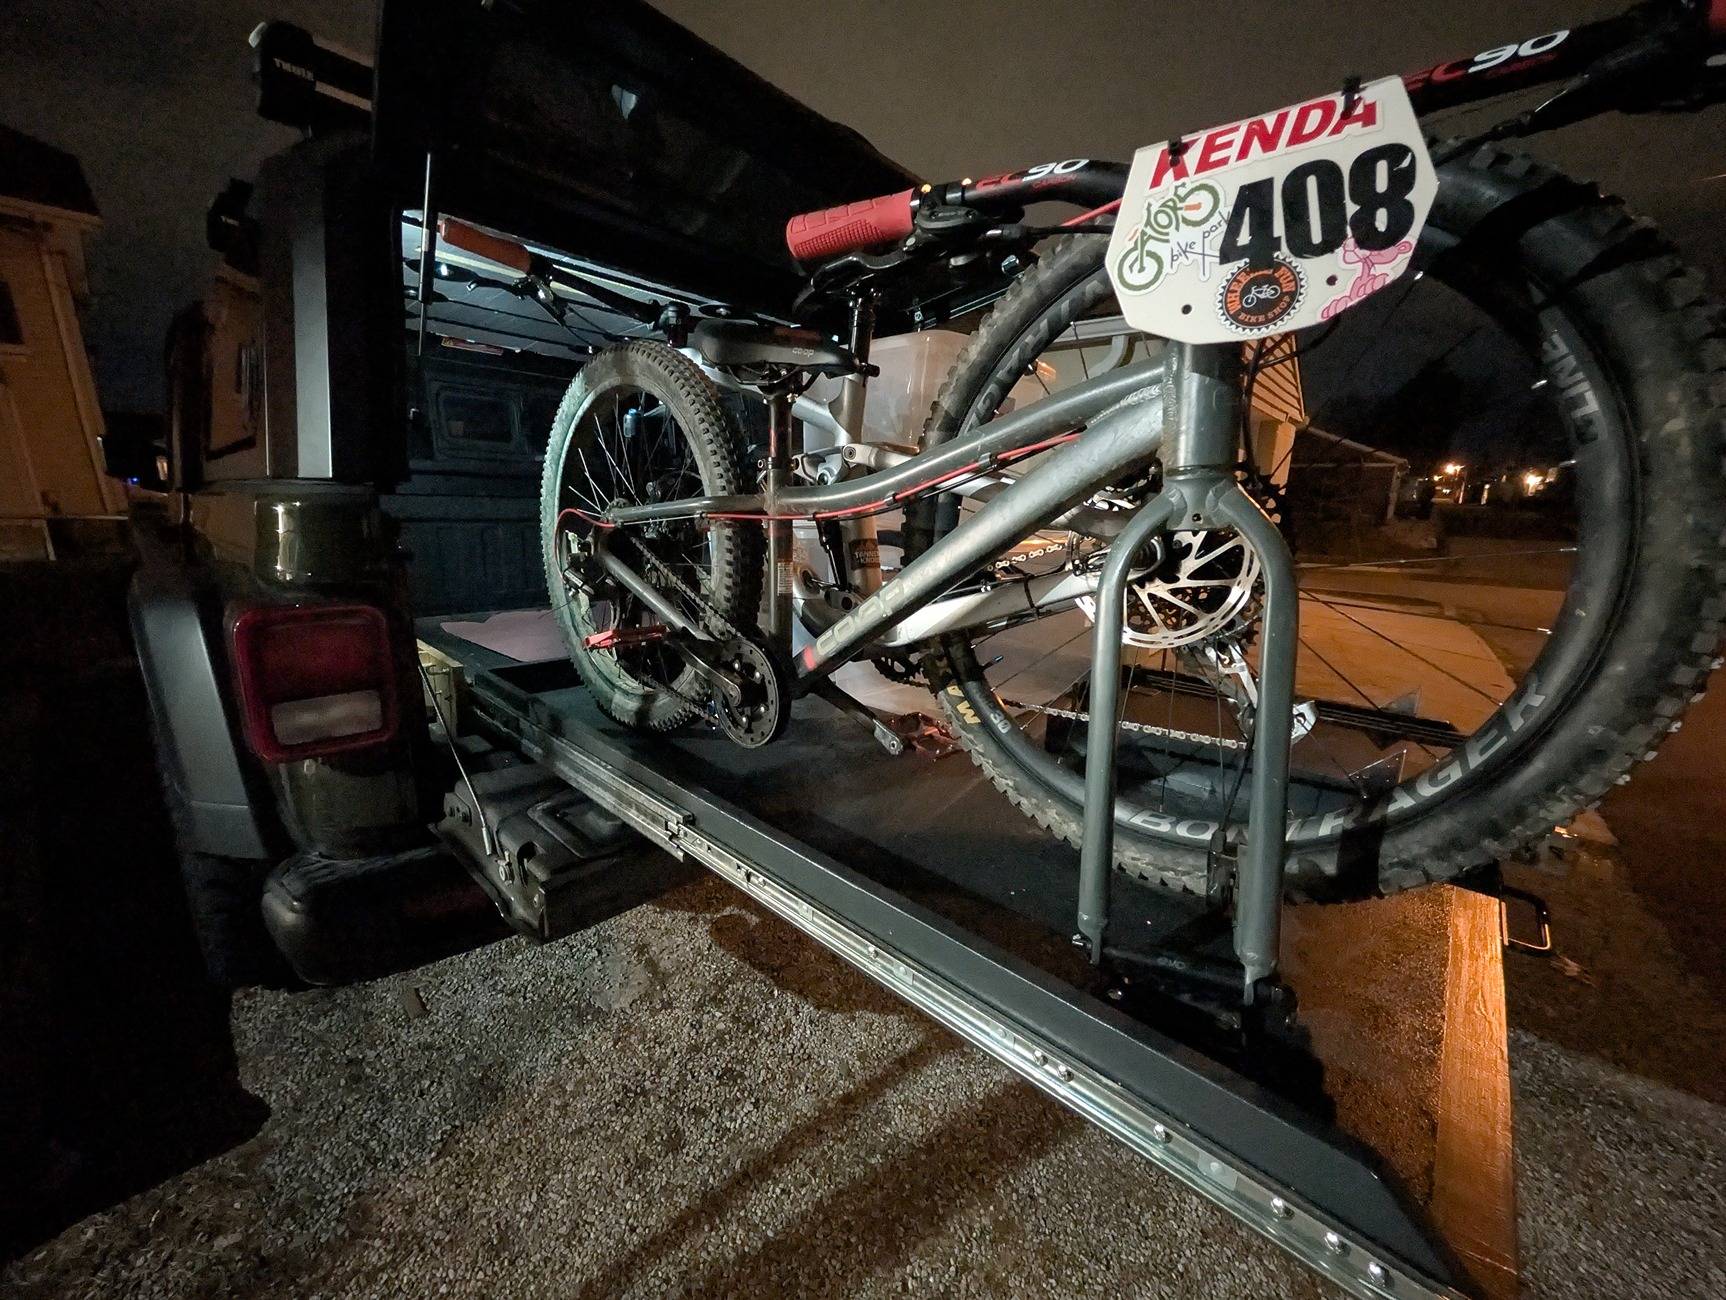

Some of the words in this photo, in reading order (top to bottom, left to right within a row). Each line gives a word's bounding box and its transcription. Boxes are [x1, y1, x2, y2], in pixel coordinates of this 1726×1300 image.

[1149, 98, 1378, 190] KENDA
[1219, 142, 1417, 269] 408
[1238, 311, 1266, 323] BIKE
[1267, 295, 1291, 319] SHOP
[1274, 265, 1296, 293] FUN
